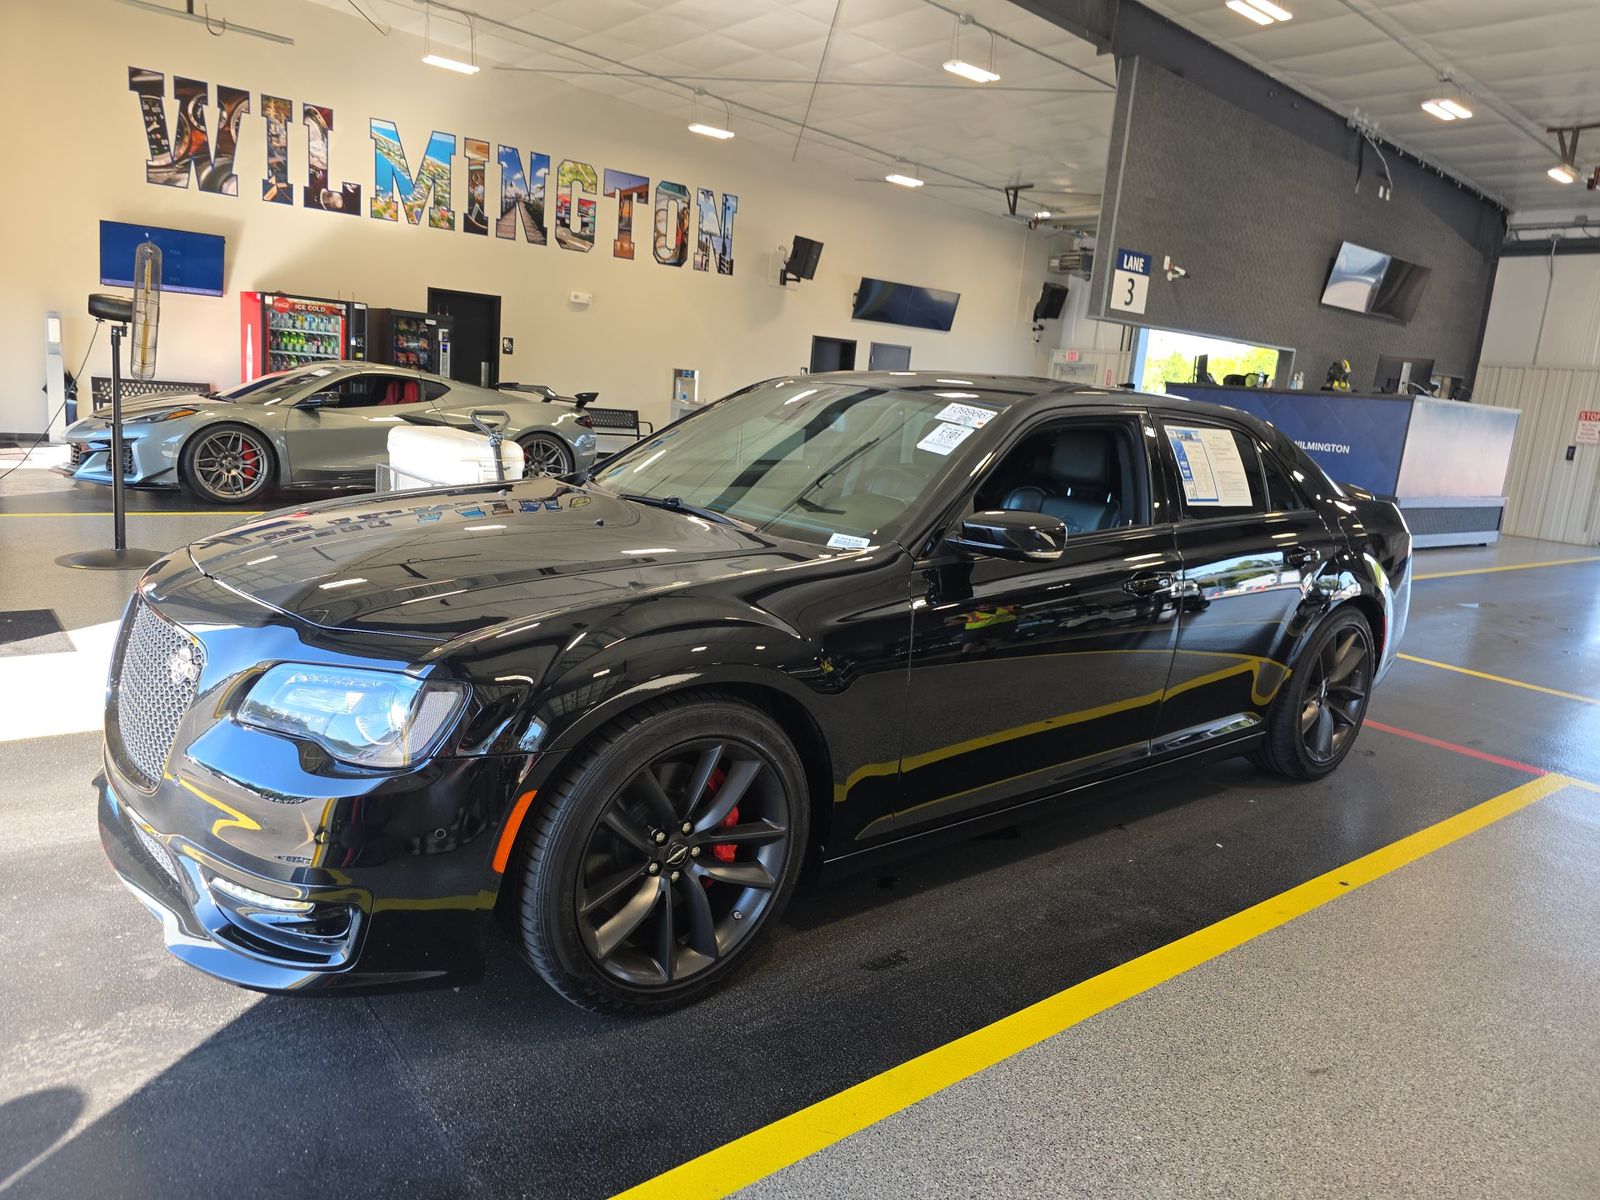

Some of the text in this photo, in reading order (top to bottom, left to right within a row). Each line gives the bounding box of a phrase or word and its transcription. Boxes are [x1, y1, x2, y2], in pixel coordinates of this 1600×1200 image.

[128, 66, 738, 275] WILMINGTON
[1123, 254, 1145, 273] LANE
[1124, 278, 1135, 306] 3
